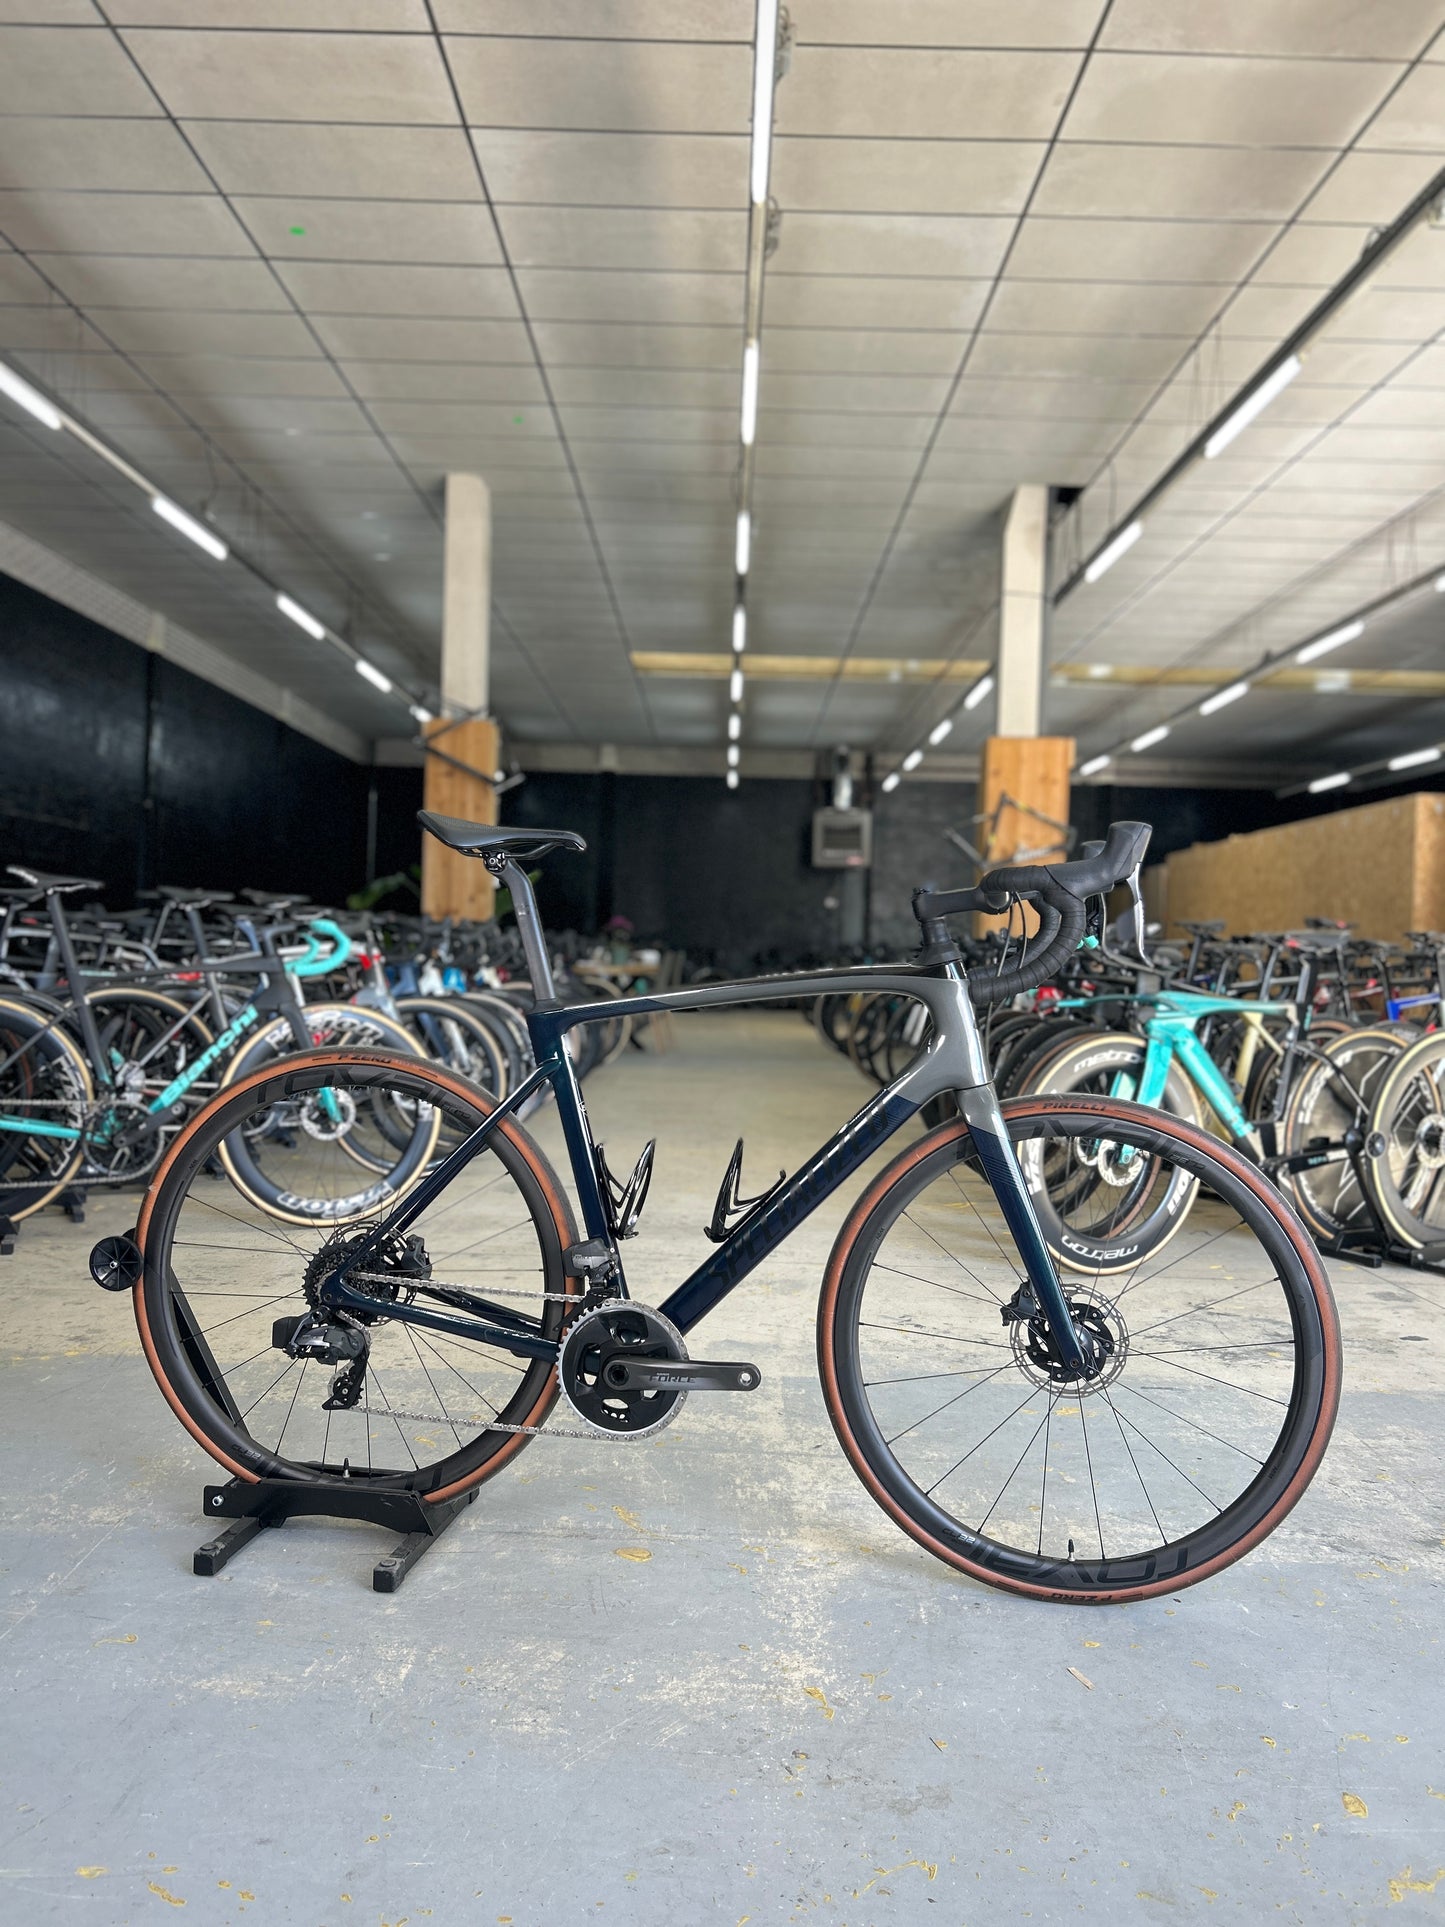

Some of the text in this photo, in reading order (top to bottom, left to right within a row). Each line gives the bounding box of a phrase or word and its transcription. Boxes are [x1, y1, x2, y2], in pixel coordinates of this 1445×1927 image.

[160, 1004, 258, 1107] Bianchi
[1074, 1050, 1143, 1072] metro
[1041, 1102, 1107, 1111] PIRELLI
[1061, 1235, 1138, 1260] metron
[650, 1375, 696, 1384] FORCE
